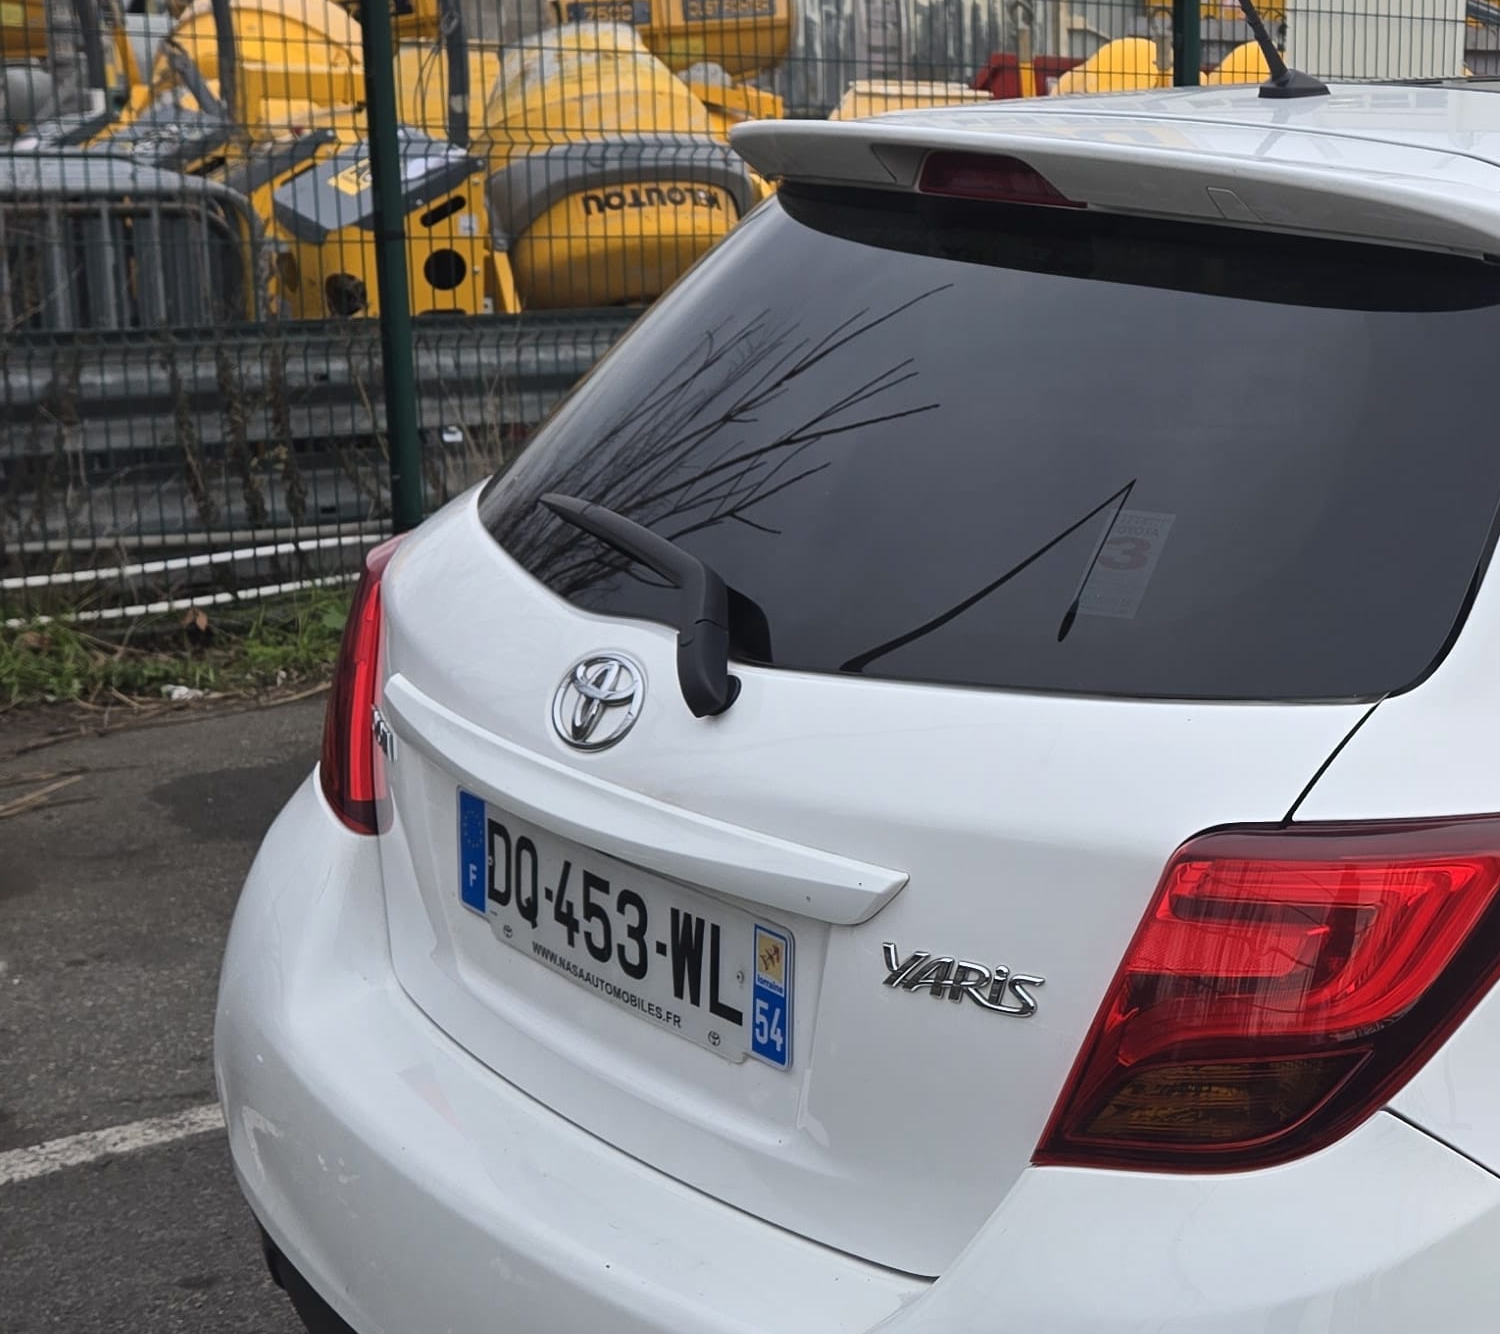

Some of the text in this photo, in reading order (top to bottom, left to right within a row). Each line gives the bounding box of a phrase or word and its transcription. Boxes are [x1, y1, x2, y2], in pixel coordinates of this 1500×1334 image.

[582, 186, 722, 216] KILOUTOU
[468, 864, 478, 887] F
[487, 817, 744, 1027] DQ-453-WL
[532, 941, 683, 1029] WWW.NASAAUTOMOBILES.FR
[755, 997, 784, 1052] 54
